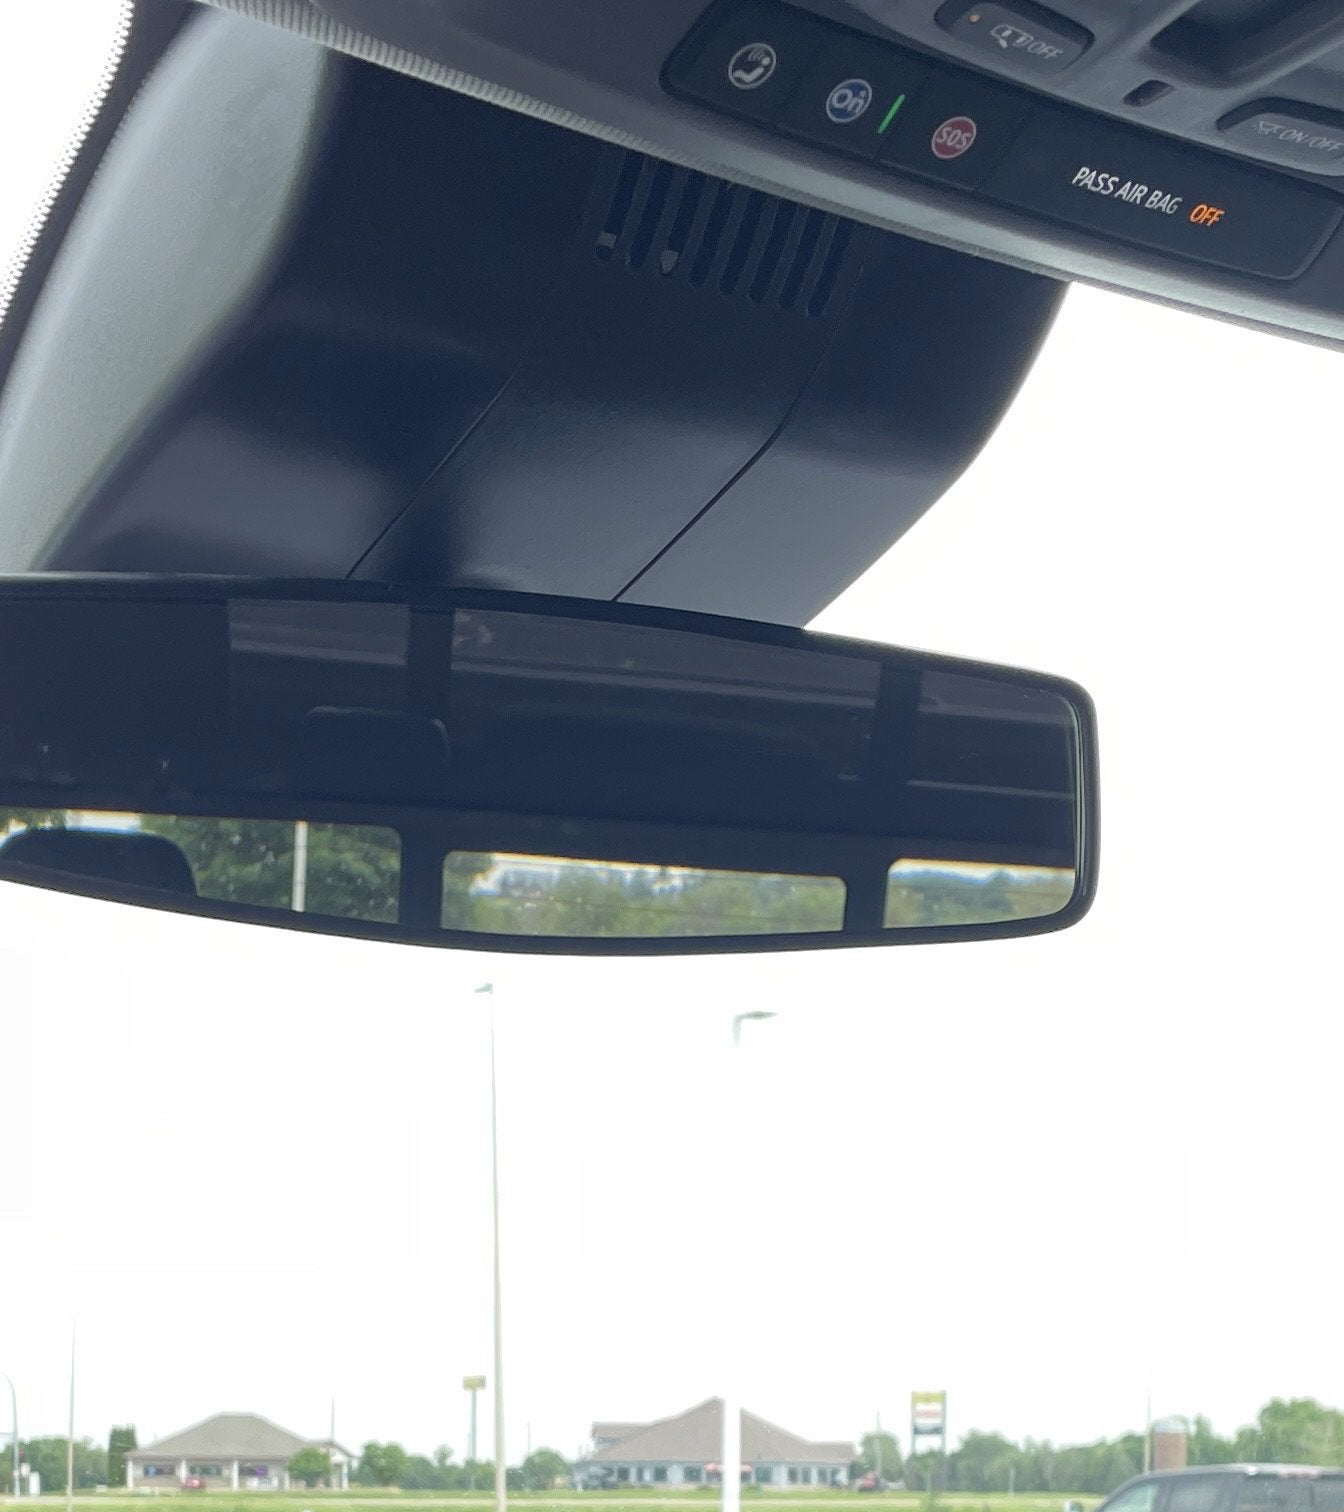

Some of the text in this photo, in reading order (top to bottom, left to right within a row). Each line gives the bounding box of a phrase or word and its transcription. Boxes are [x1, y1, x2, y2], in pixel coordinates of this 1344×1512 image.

[936, 126, 972, 149] SOS
[1072, 166, 1225, 227] PASS AIR BAG OFF
